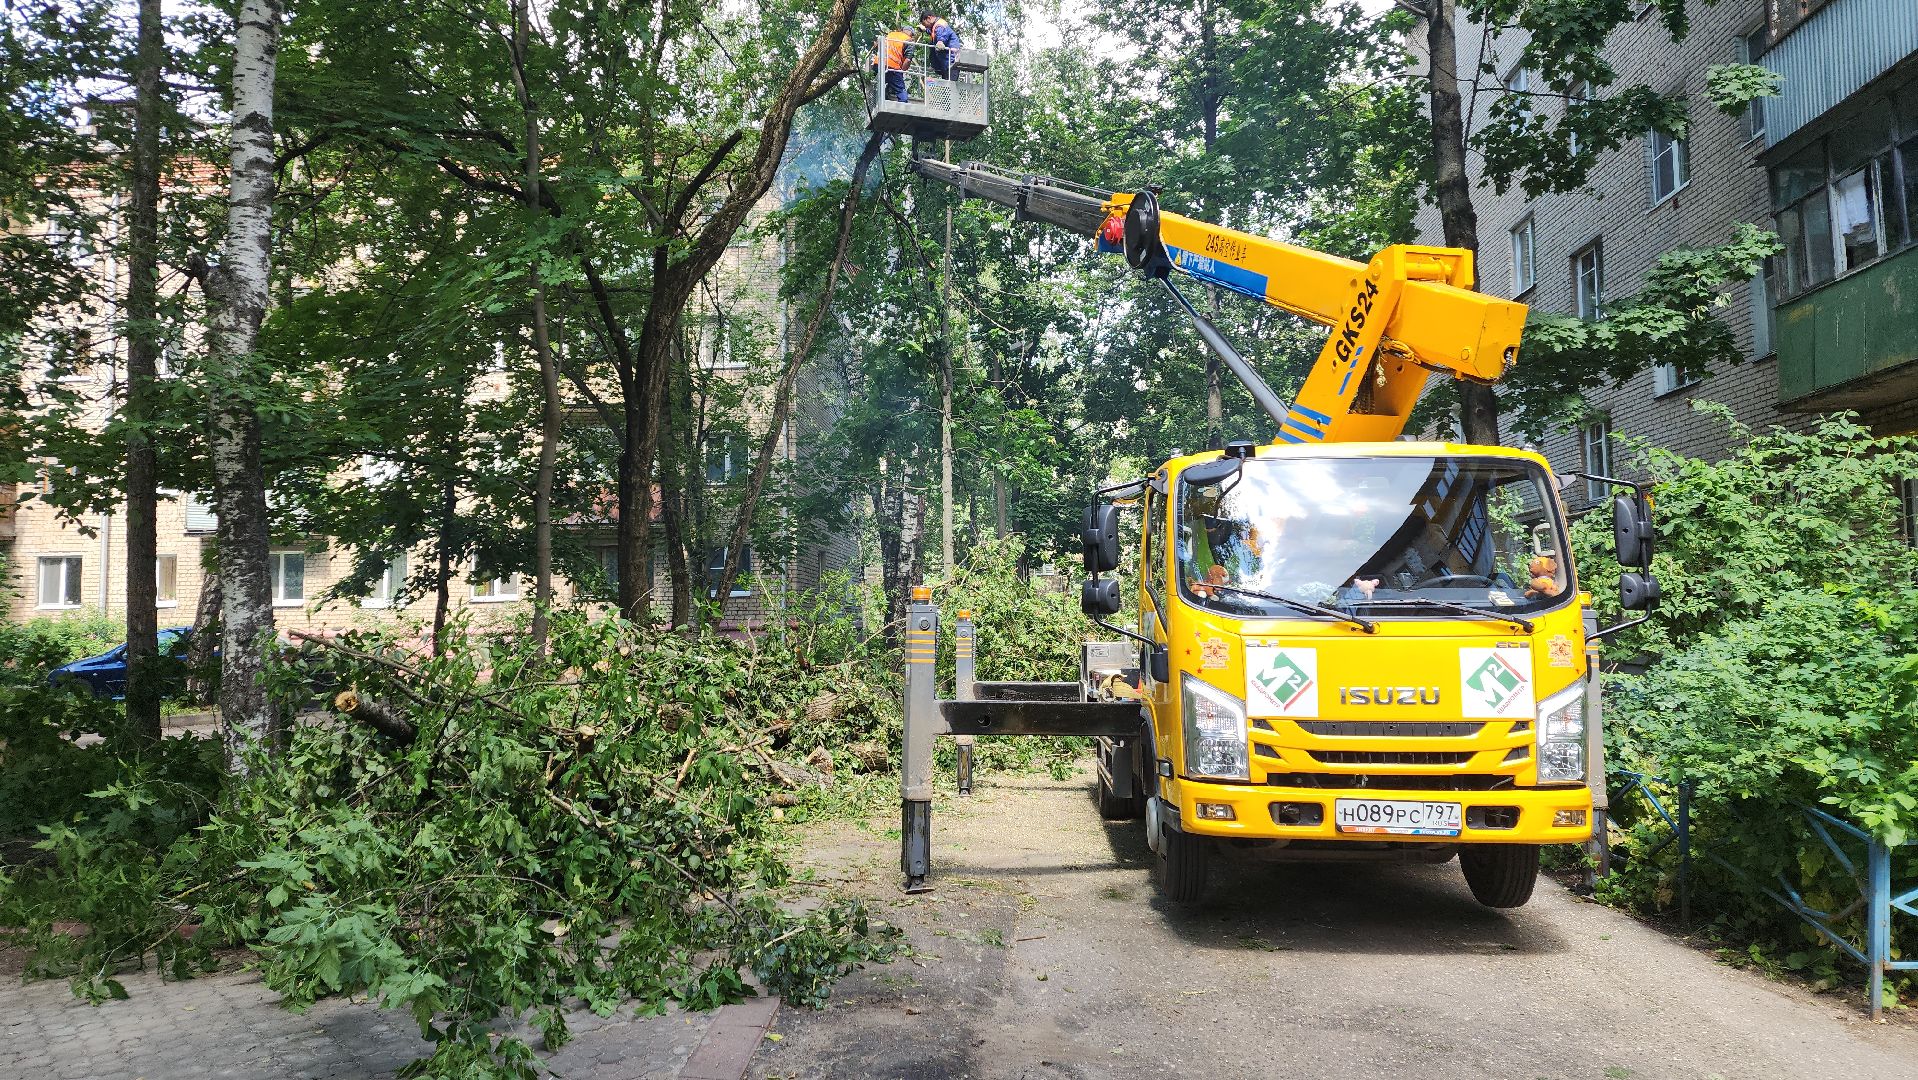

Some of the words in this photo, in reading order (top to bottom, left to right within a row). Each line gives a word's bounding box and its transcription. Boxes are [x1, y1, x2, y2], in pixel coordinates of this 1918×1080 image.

[1336, 279, 1379, 362] GKS24
[1339, 686, 1440, 705] ISUZU
[1425, 805, 1454, 820] 797
